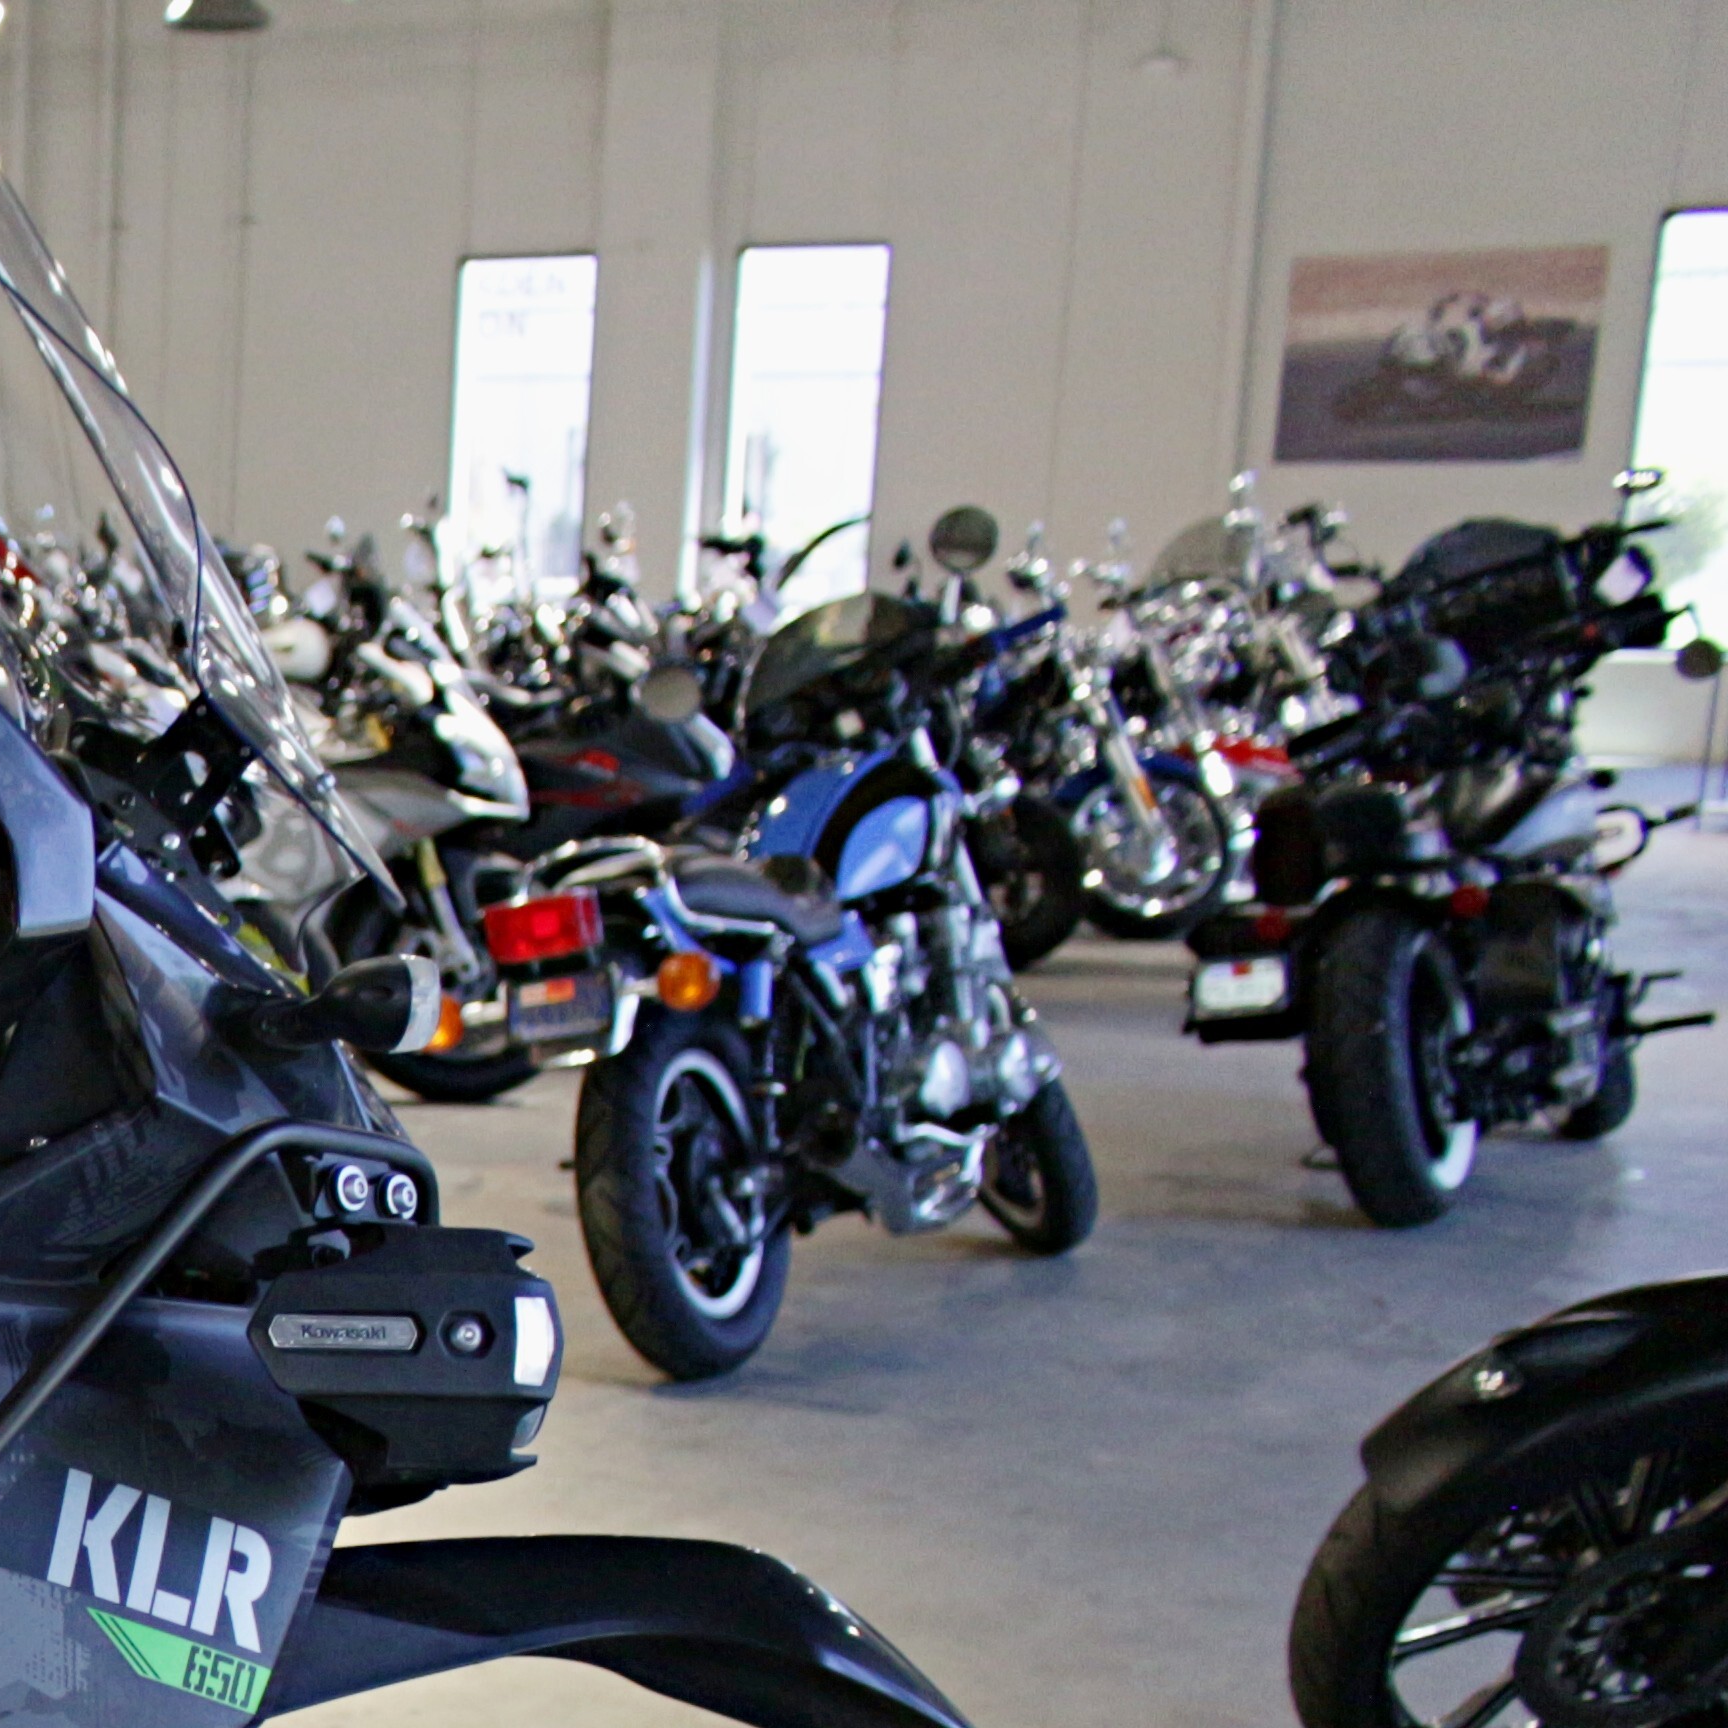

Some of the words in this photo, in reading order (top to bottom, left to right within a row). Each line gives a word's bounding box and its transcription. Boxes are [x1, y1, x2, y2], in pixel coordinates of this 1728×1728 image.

[300, 1323, 387, 1341] Kawasaki
[45, 1466, 273, 1655] KLR
[181, 1644, 258, 1708] 650
